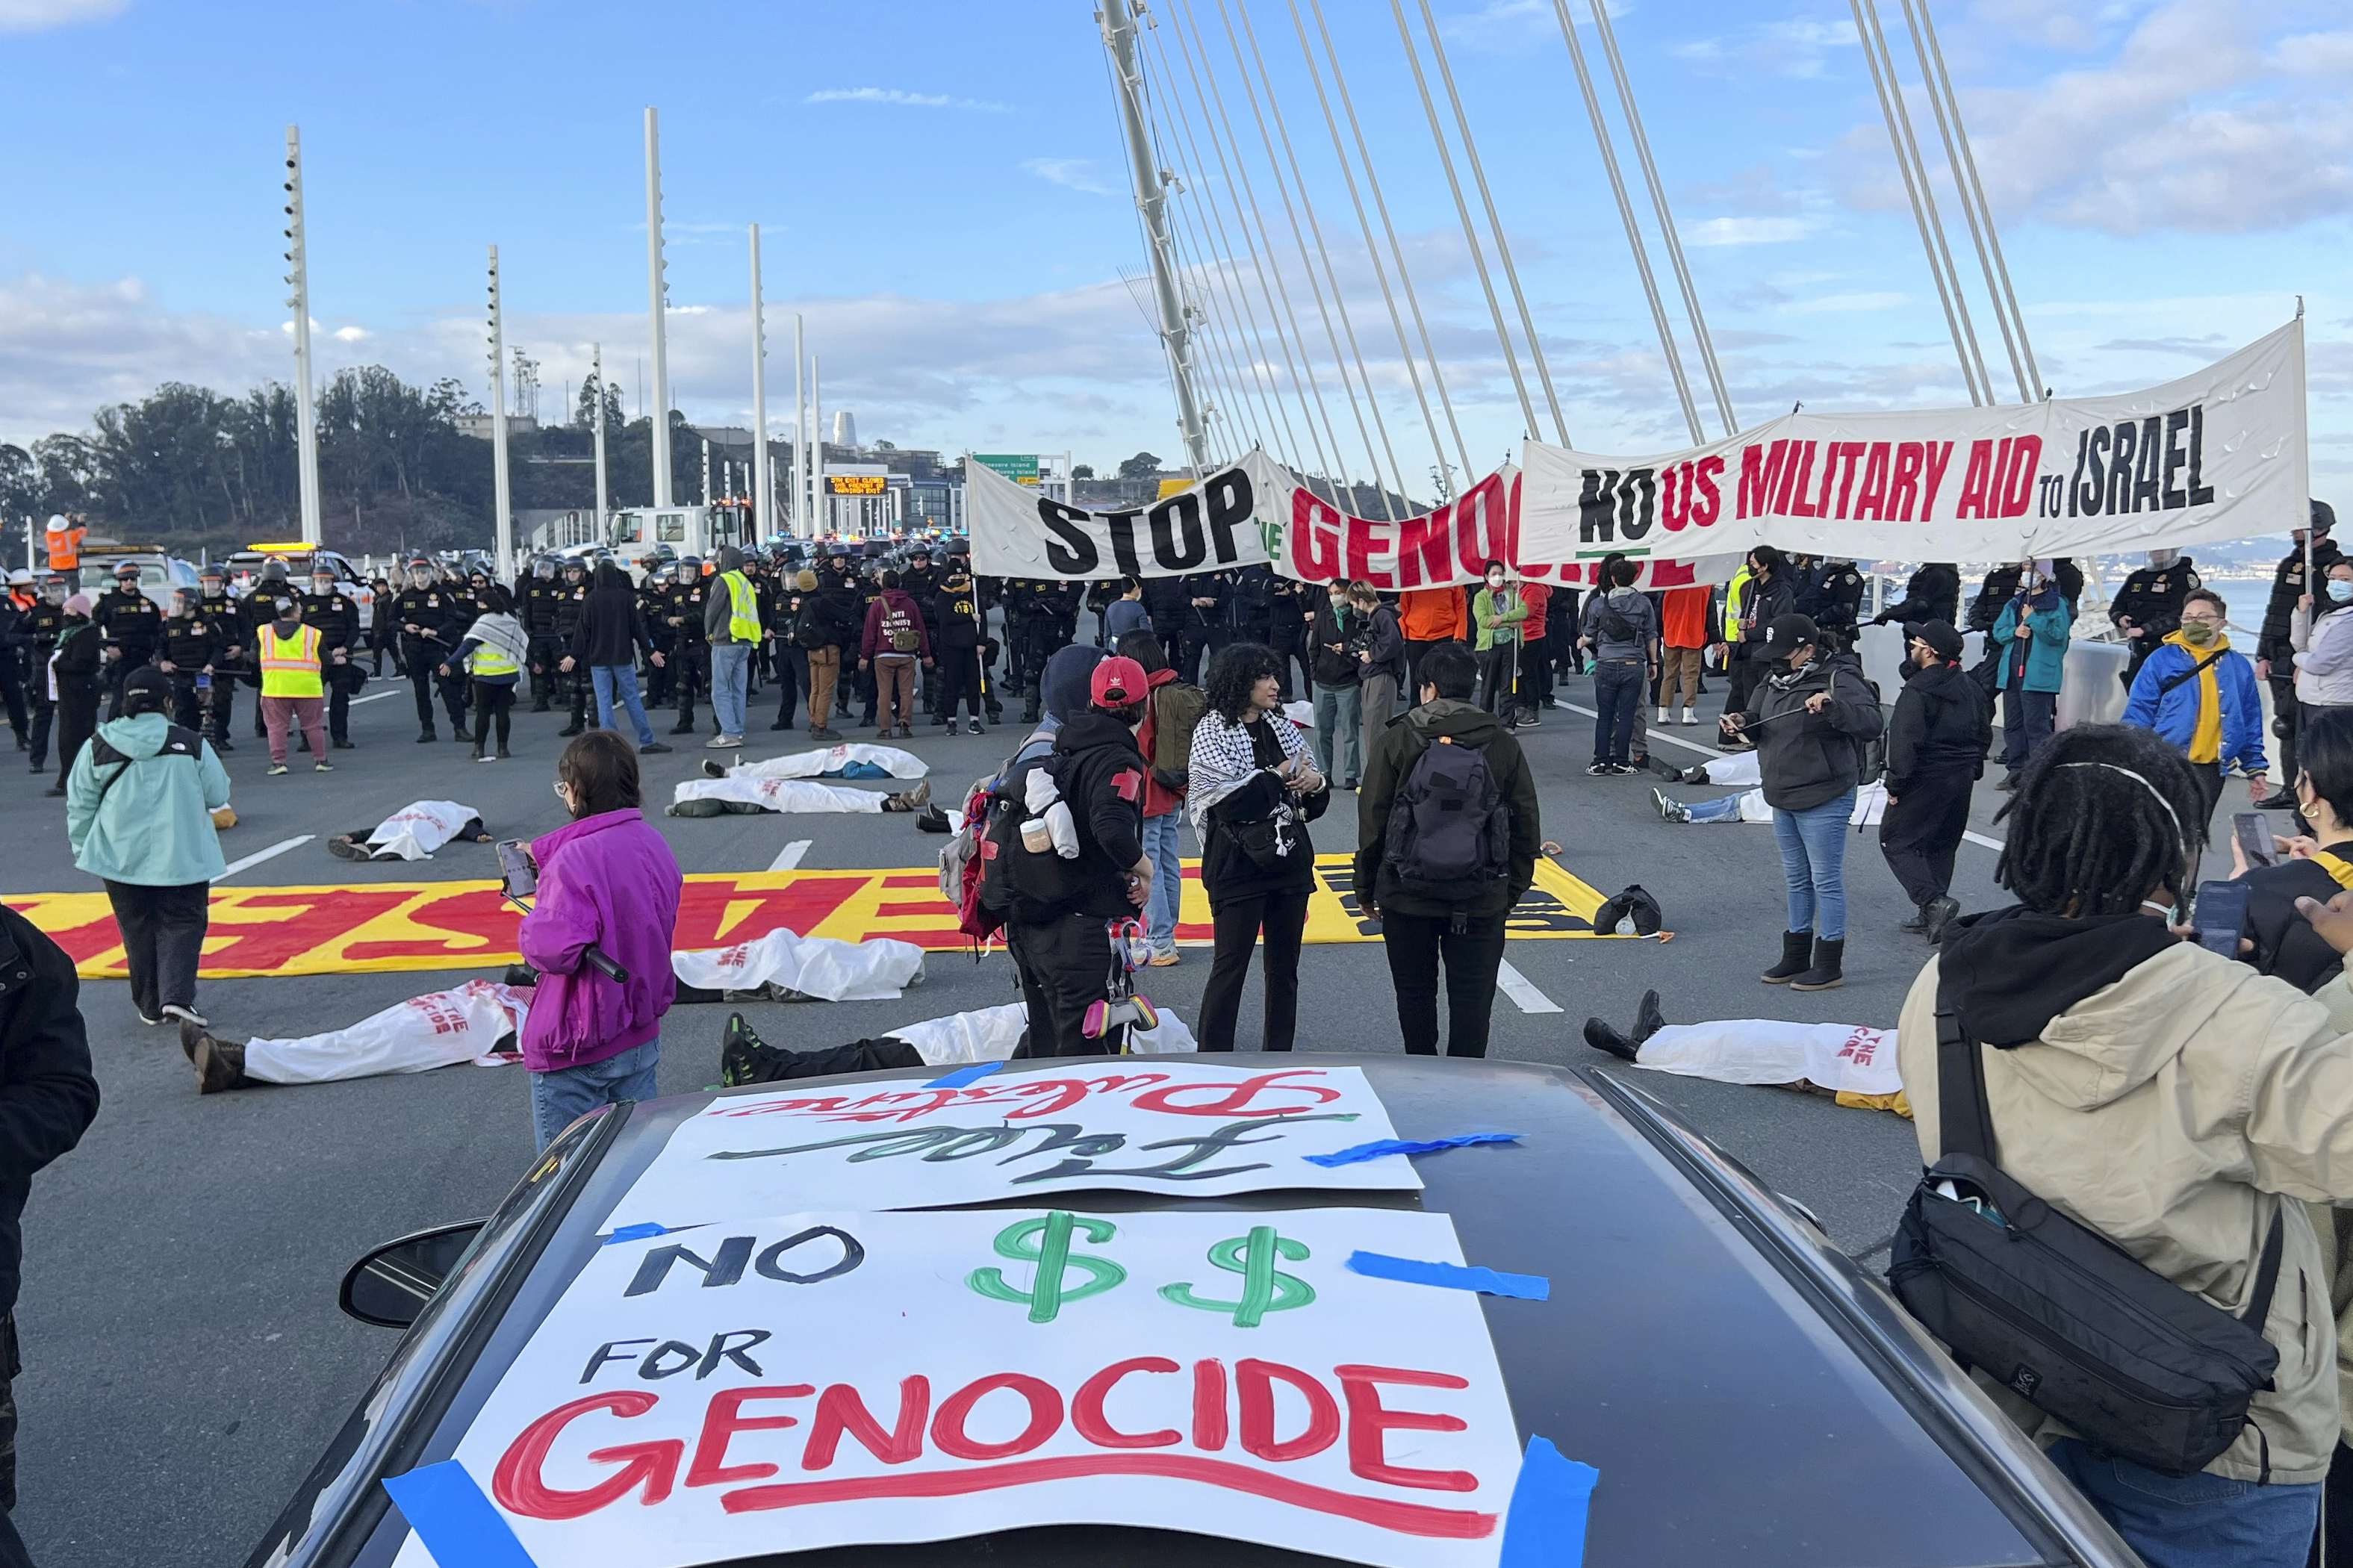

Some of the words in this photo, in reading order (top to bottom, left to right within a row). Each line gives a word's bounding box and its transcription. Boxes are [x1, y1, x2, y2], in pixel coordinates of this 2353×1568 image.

[1579, 469, 1656, 542] NO
[1662, 455, 1725, 532] US
[1737, 439, 1954, 522] MILITARY
[1956, 435, 2042, 519] AID
[2040, 475, 2064, 518] TO
[2069, 405, 2214, 517] ISRAEL
[1038, 468, 1255, 575] STOP
[886, 610, 905, 619] NTI
[624, 1225, 865, 1297] NO
[579, 1328, 771, 1384] FOR
[492, 1356, 1479, 1520] GENOCIDE
